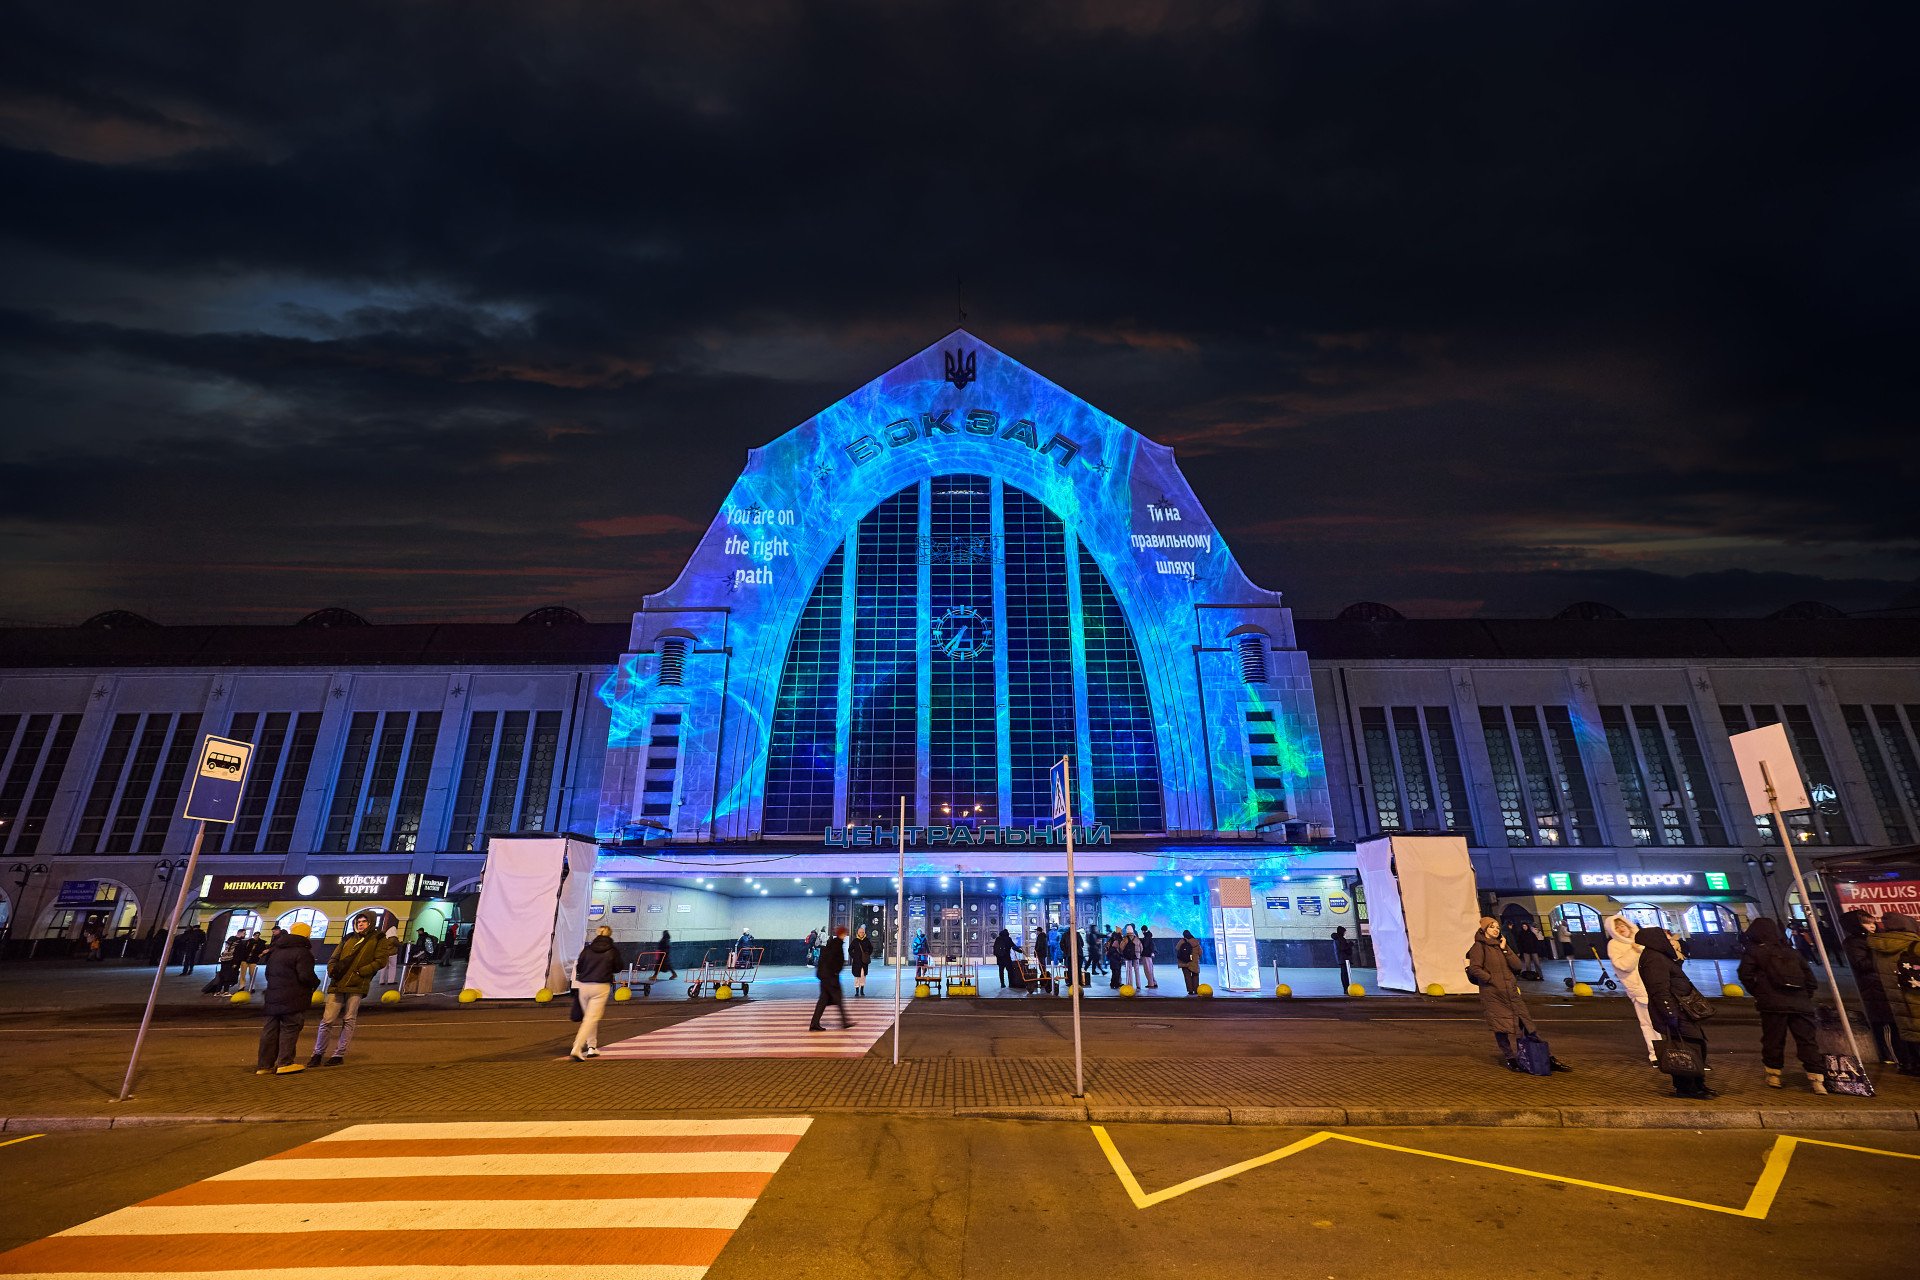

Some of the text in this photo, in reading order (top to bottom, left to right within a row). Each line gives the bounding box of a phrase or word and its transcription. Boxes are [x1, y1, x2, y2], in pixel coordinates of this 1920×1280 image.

[845, 409, 1082, 468] ВОКЗАЛ
[727, 505, 795, 525] You are on
[1146, 504, 1182, 522] Ти на
[724, 534, 789, 562] the right
[1131, 534, 1211, 554] правильному
[734, 565, 773, 589] path
[1155, 560, 1195, 580] шляху
[824, 822, 1112, 848] ЦЕНТРАЛЬНИЙ
[223, 881, 286, 890] МІНІМАРКЕТ
[338, 874, 389, 885] КИЇВСЬКІ
[344, 885, 379, 894] ТОРТИ
[1581, 874, 1615, 886] ВСЕ
[1616, 874, 1629, 886] В
[1631, 874, 1692, 887] ДОРОГУ
[1851, 885, 1920, 900] PAVLUKS
